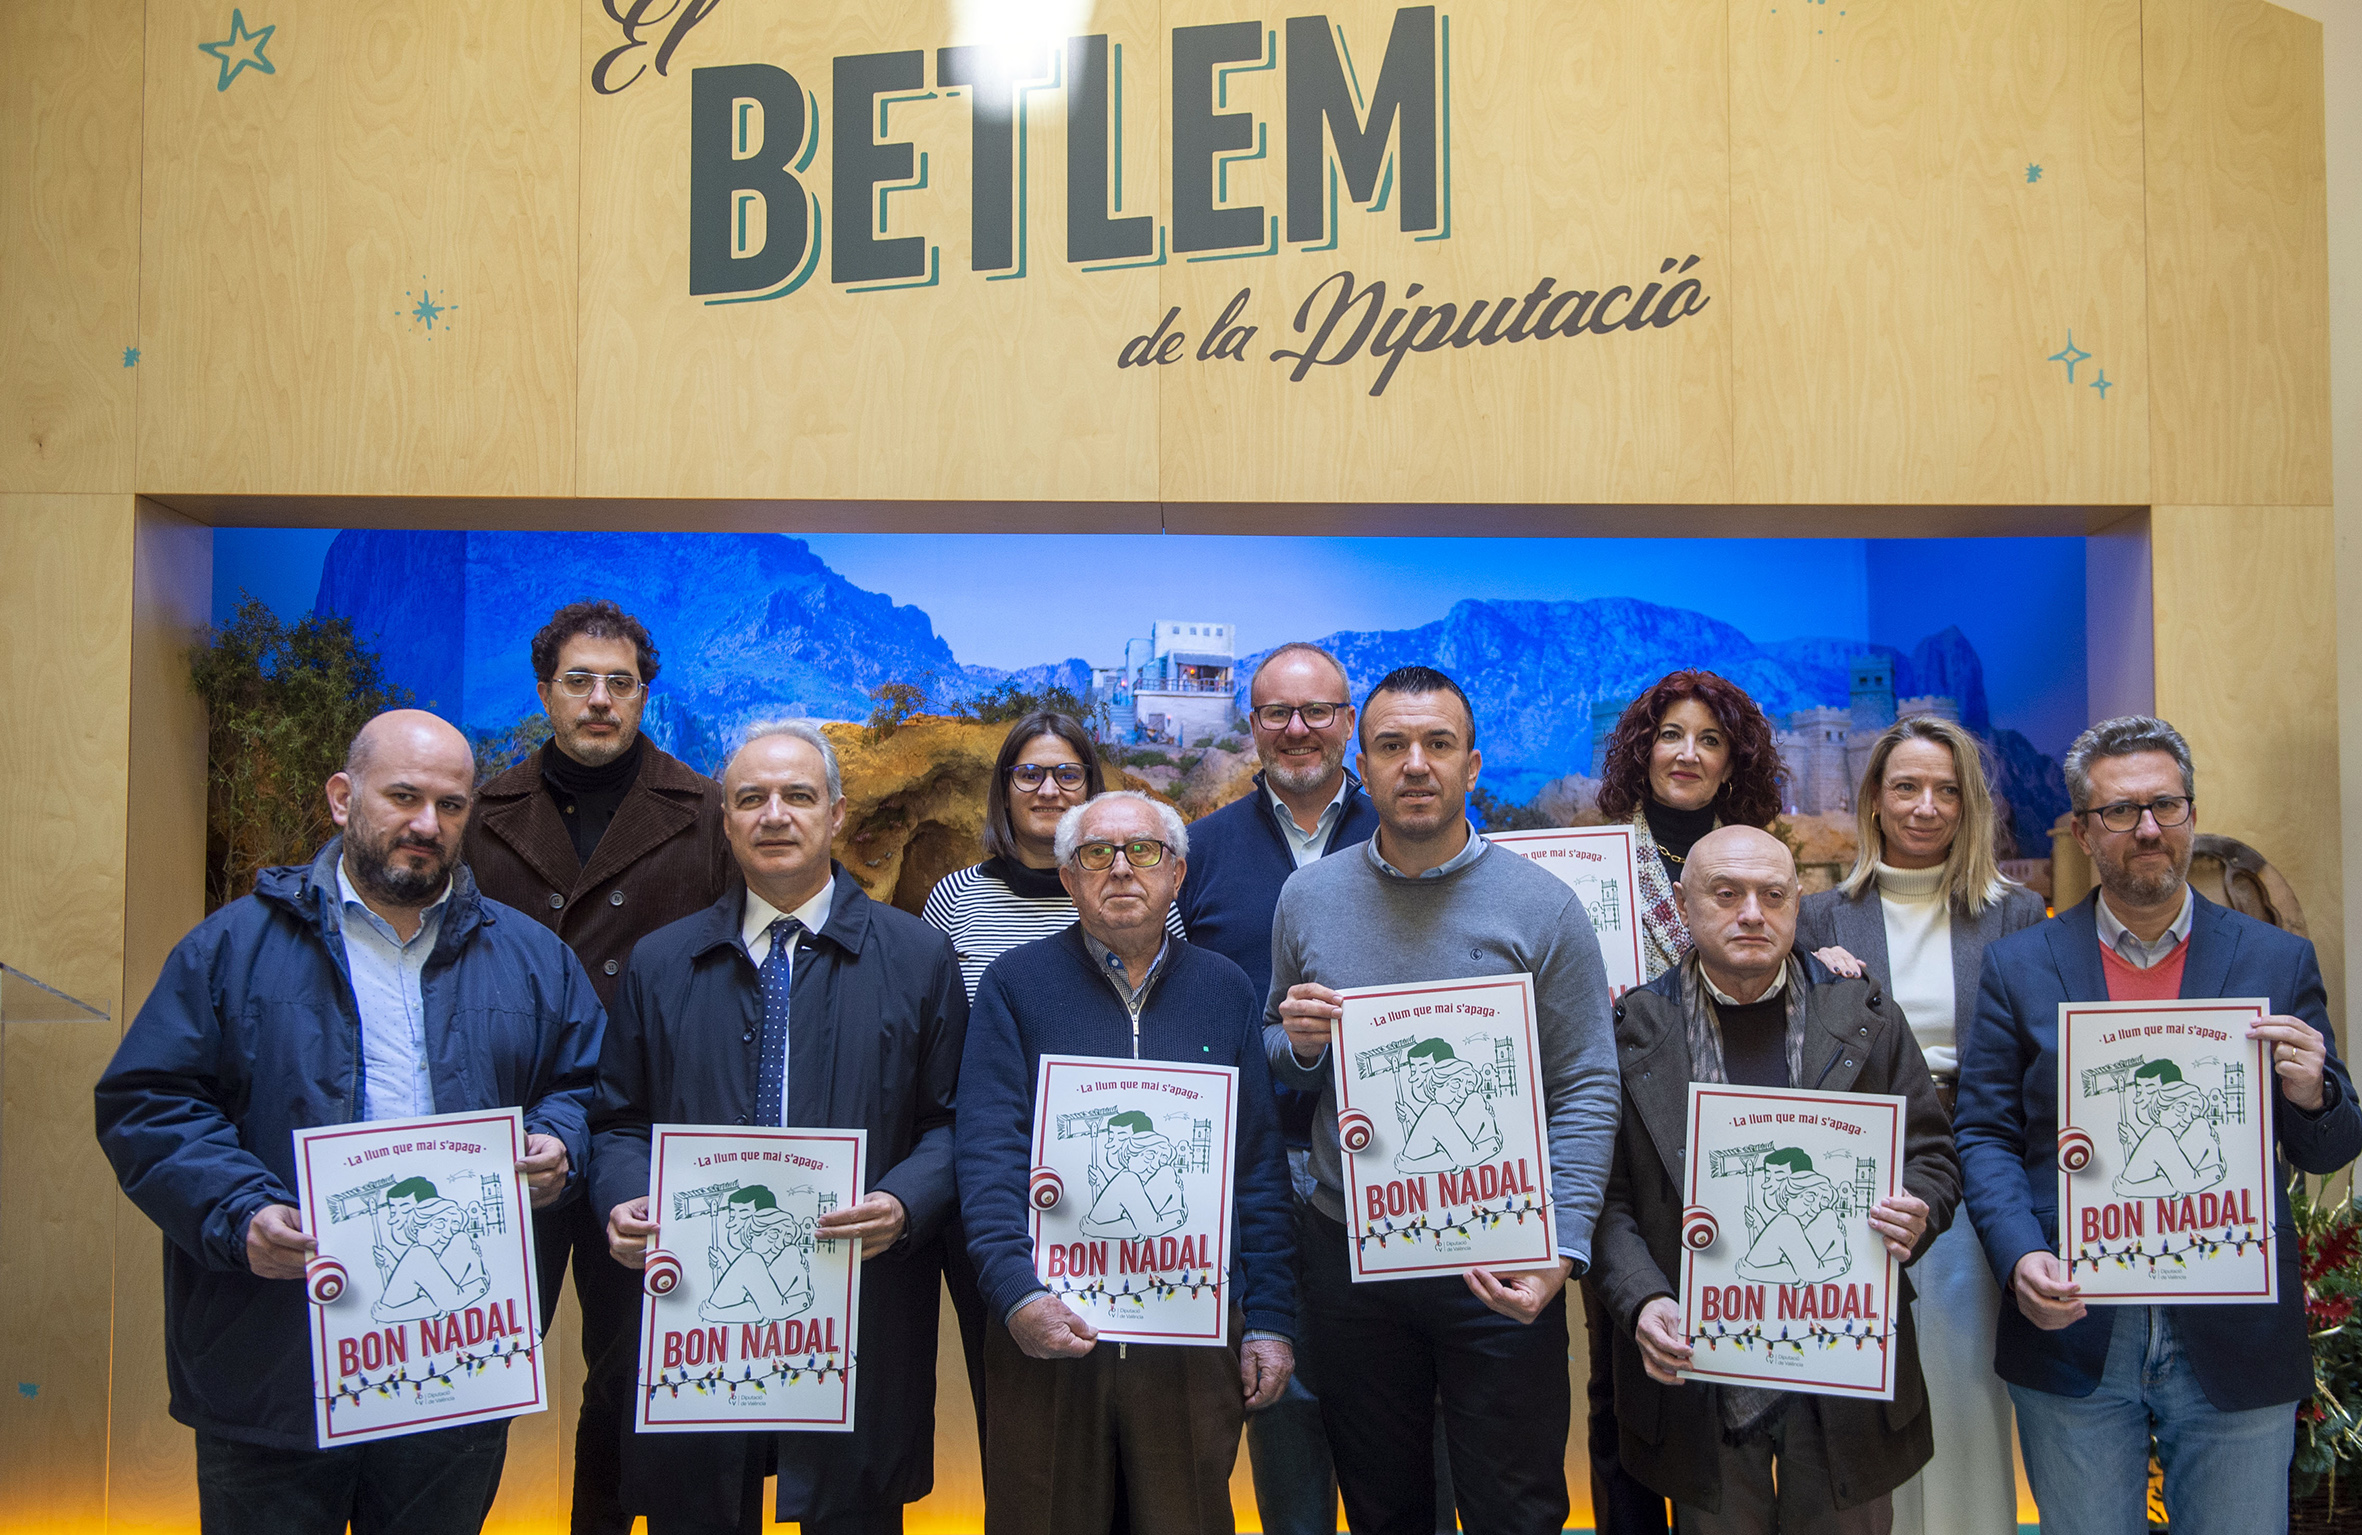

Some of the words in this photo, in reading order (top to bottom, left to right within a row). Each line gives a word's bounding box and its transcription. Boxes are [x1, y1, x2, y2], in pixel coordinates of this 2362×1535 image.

[591, 0, 721, 95] El
[690, 5, 1451, 305] BETLEM
[1117, 306, 1183, 368] de
[1196, 287, 1259, 362] la
[1270, 254, 1711, 397] Diputació
[1531, 850, 1547, 860] que
[1550, 849, 1566, 857] mai
[1569, 849, 1602, 862] s'apaga
[1373, 1016, 1387, 1027] La
[1388, 1009, 1411, 1022] llum
[1413, 1005, 1432, 1017] que
[1435, 1003, 1453, 1014] mai
[1456, 1003, 1495, 1017] s'apaga
[2103, 1033, 2116, 1044] La
[2118, 1027, 2141, 1040] llum
[2144, 1025, 2163, 1036] que
[2166, 1024, 2185, 1034] mai
[2187, 1025, 2227, 1041] s'apaga
[1080, 1084, 1092, 1094] La
[1095, 1081, 1117, 1091] llum
[1120, 1080, 1138, 1090] que
[1141, 1081, 1159, 1091] mai
[1162, 1083, 1199, 1100] s'apaga
[1733, 1116, 1746, 1127] La
[1749, 1113, 1772, 1124] llum
[1776, 1113, 1795, 1124] que
[1798, 1113, 1818, 1124] mai
[1821, 1116, 1861, 1135] s'apaga
[347, 1155, 362, 1167] La
[364, 1147, 390, 1161] llum
[393, 1143, 413, 1155] que
[416, 1140, 436, 1151] mai
[440, 1140, 481, 1154] s'apaga
[698, 1156, 711, 1167] La
[714, 1152, 737, 1164] llum
[741, 1151, 760, 1162] que
[763, 1151, 781, 1161] mai
[784, 1153, 824, 1170] s'apaga
[1366, 1175, 1427, 1221] BON
[1438, 1158, 1536, 1210] NADAL
[2081, 1200, 2145, 1243] BON
[2157, 1188, 2258, 1235] NADAL
[1048, 1241, 1109, 1278] BON
[1119, 1234, 1214, 1275] NADAL
[1702, 1285, 1766, 1322] BON
[1778, 1283, 1880, 1321] NADAL
[338, 1325, 409, 1378] BON
[421, 1298, 524, 1357] NADAL
[664, 1326, 729, 1369] BON
[741, 1317, 841, 1361] NADAL
